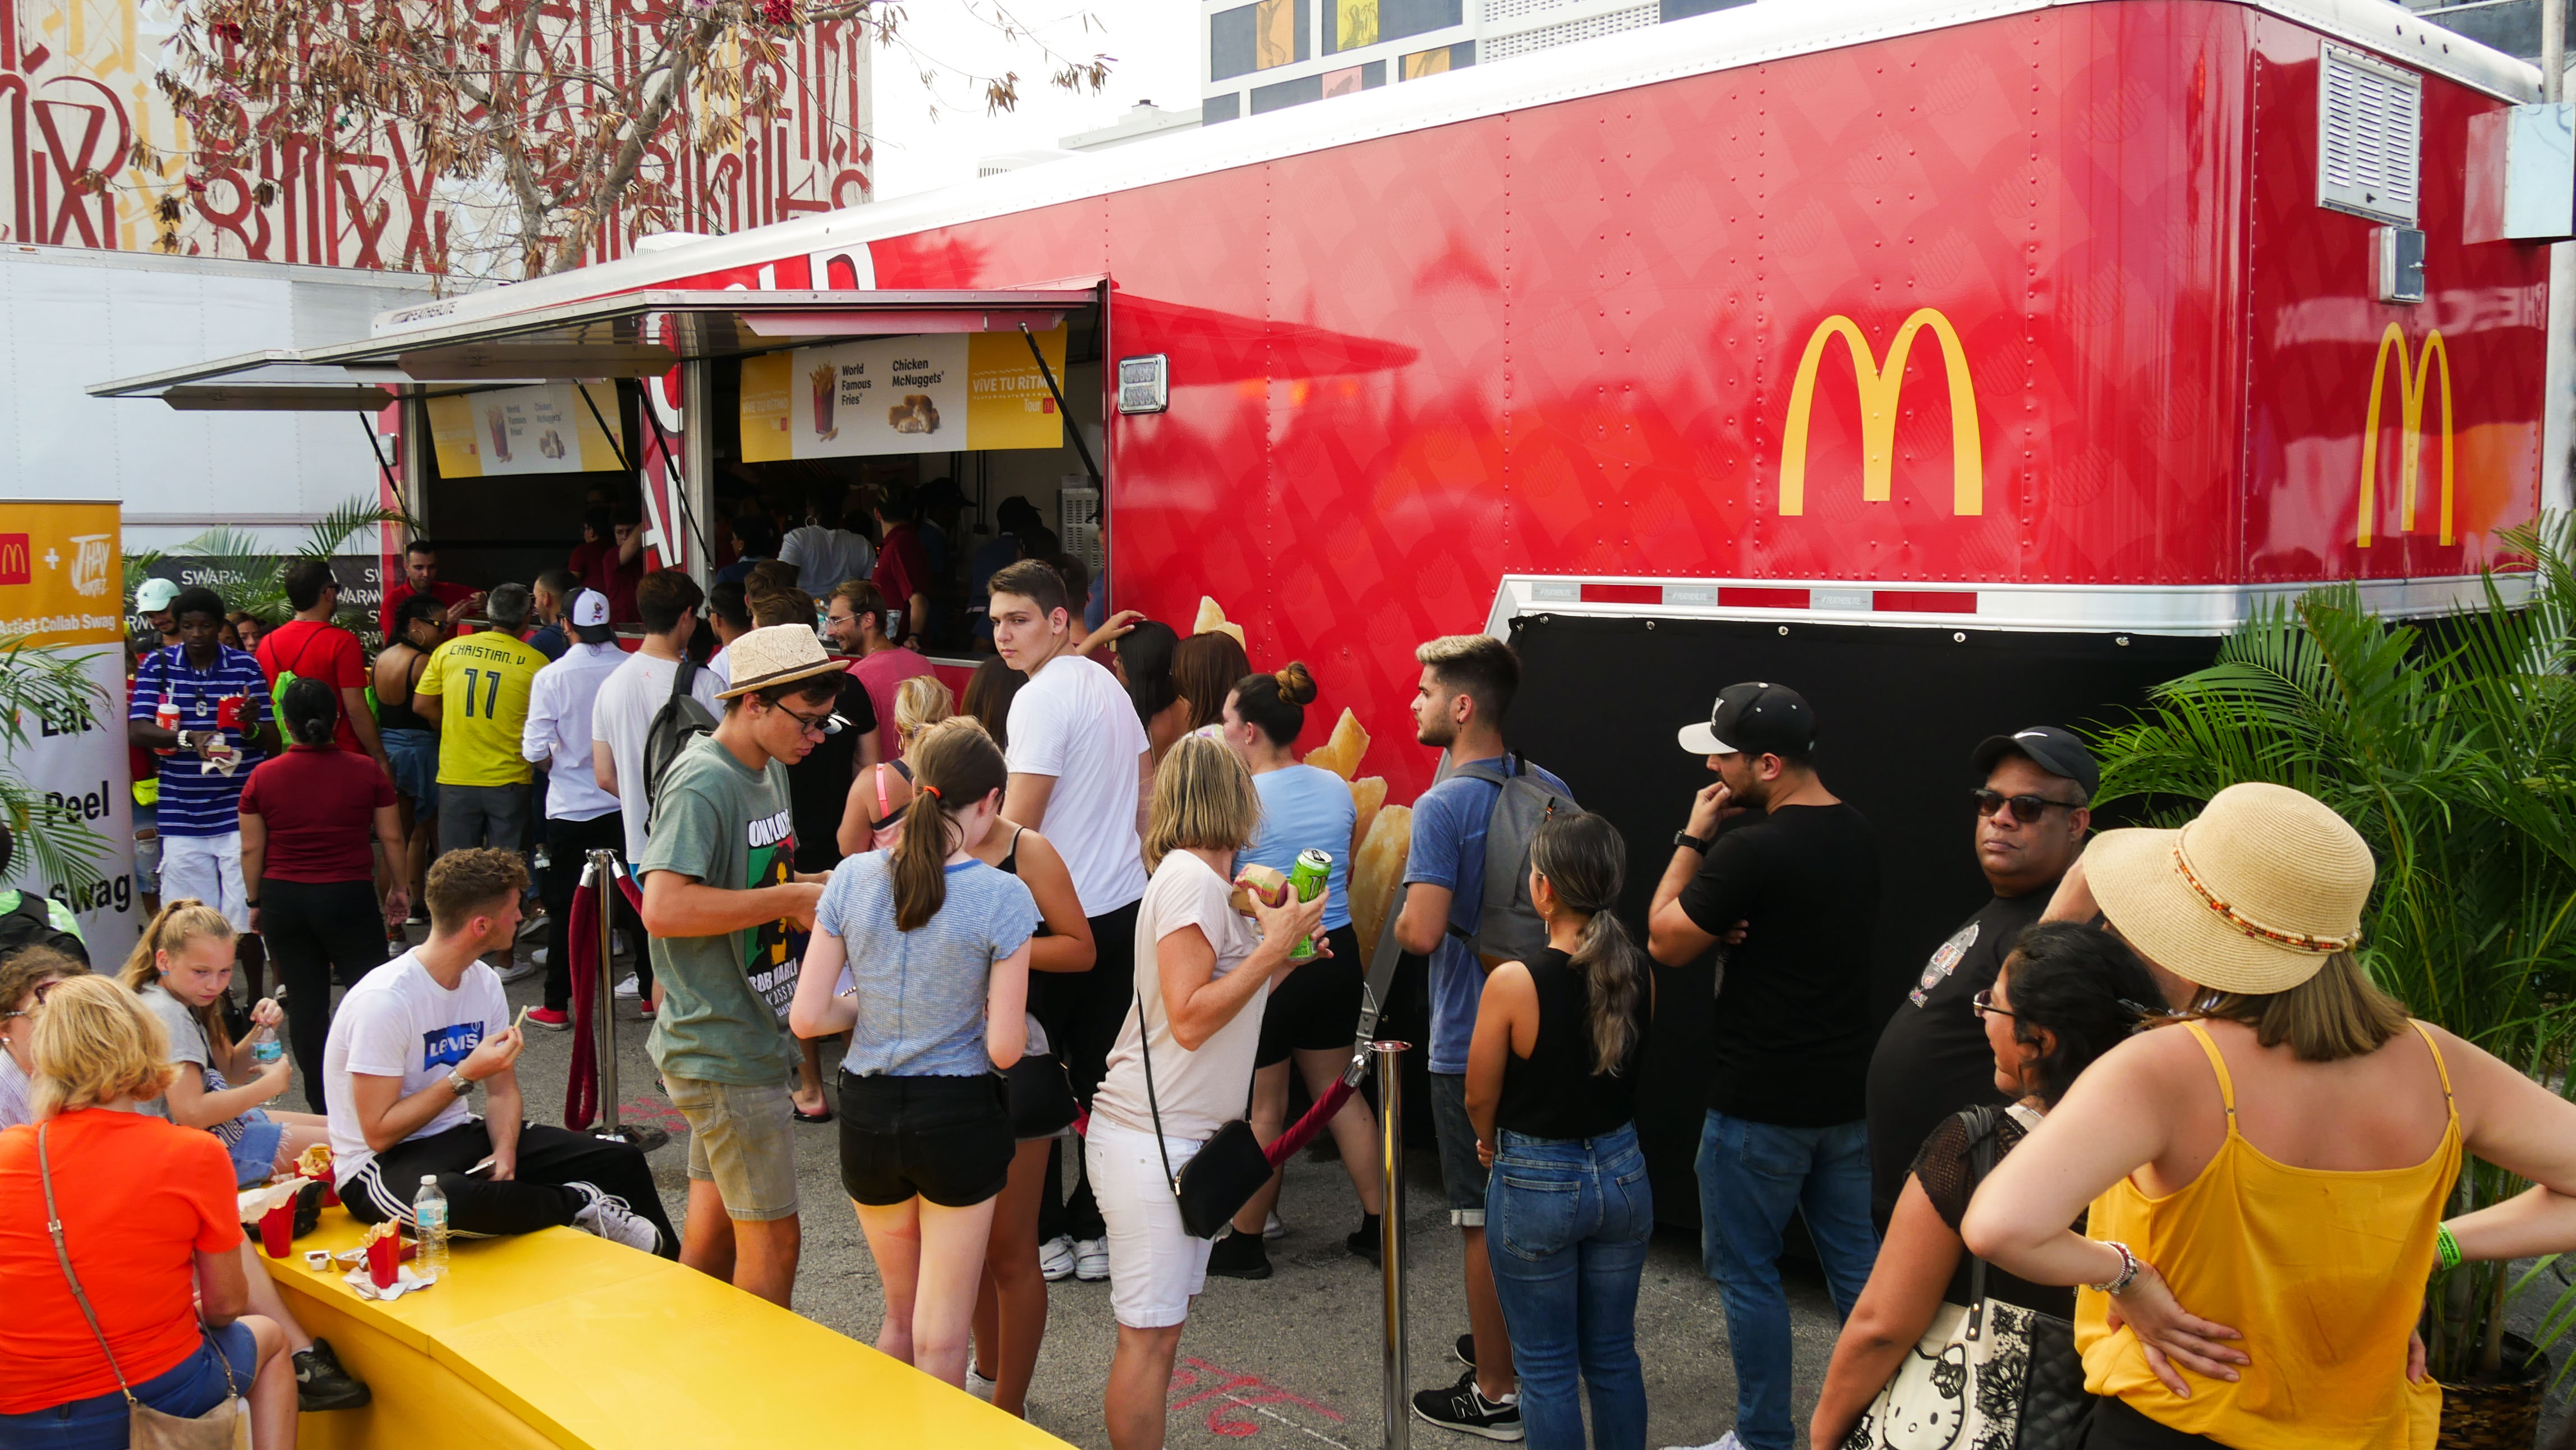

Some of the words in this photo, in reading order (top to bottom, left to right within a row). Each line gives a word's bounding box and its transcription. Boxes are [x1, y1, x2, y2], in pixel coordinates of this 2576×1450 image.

[842, 364, 864, 377] World
[893, 359, 928, 372] Chicken
[842, 378, 871, 391] Famous
[1000, 377, 1015, 391] TU
[181, 568, 246, 586] SWARM
[337, 587, 383, 606] WARM
[40, 614, 80, 632] Collab
[82, 613, 116, 631] Swag
[464, 668, 501, 720] 11
[42, 698, 92, 737] Eat
[45, 781, 109, 827] Peel
